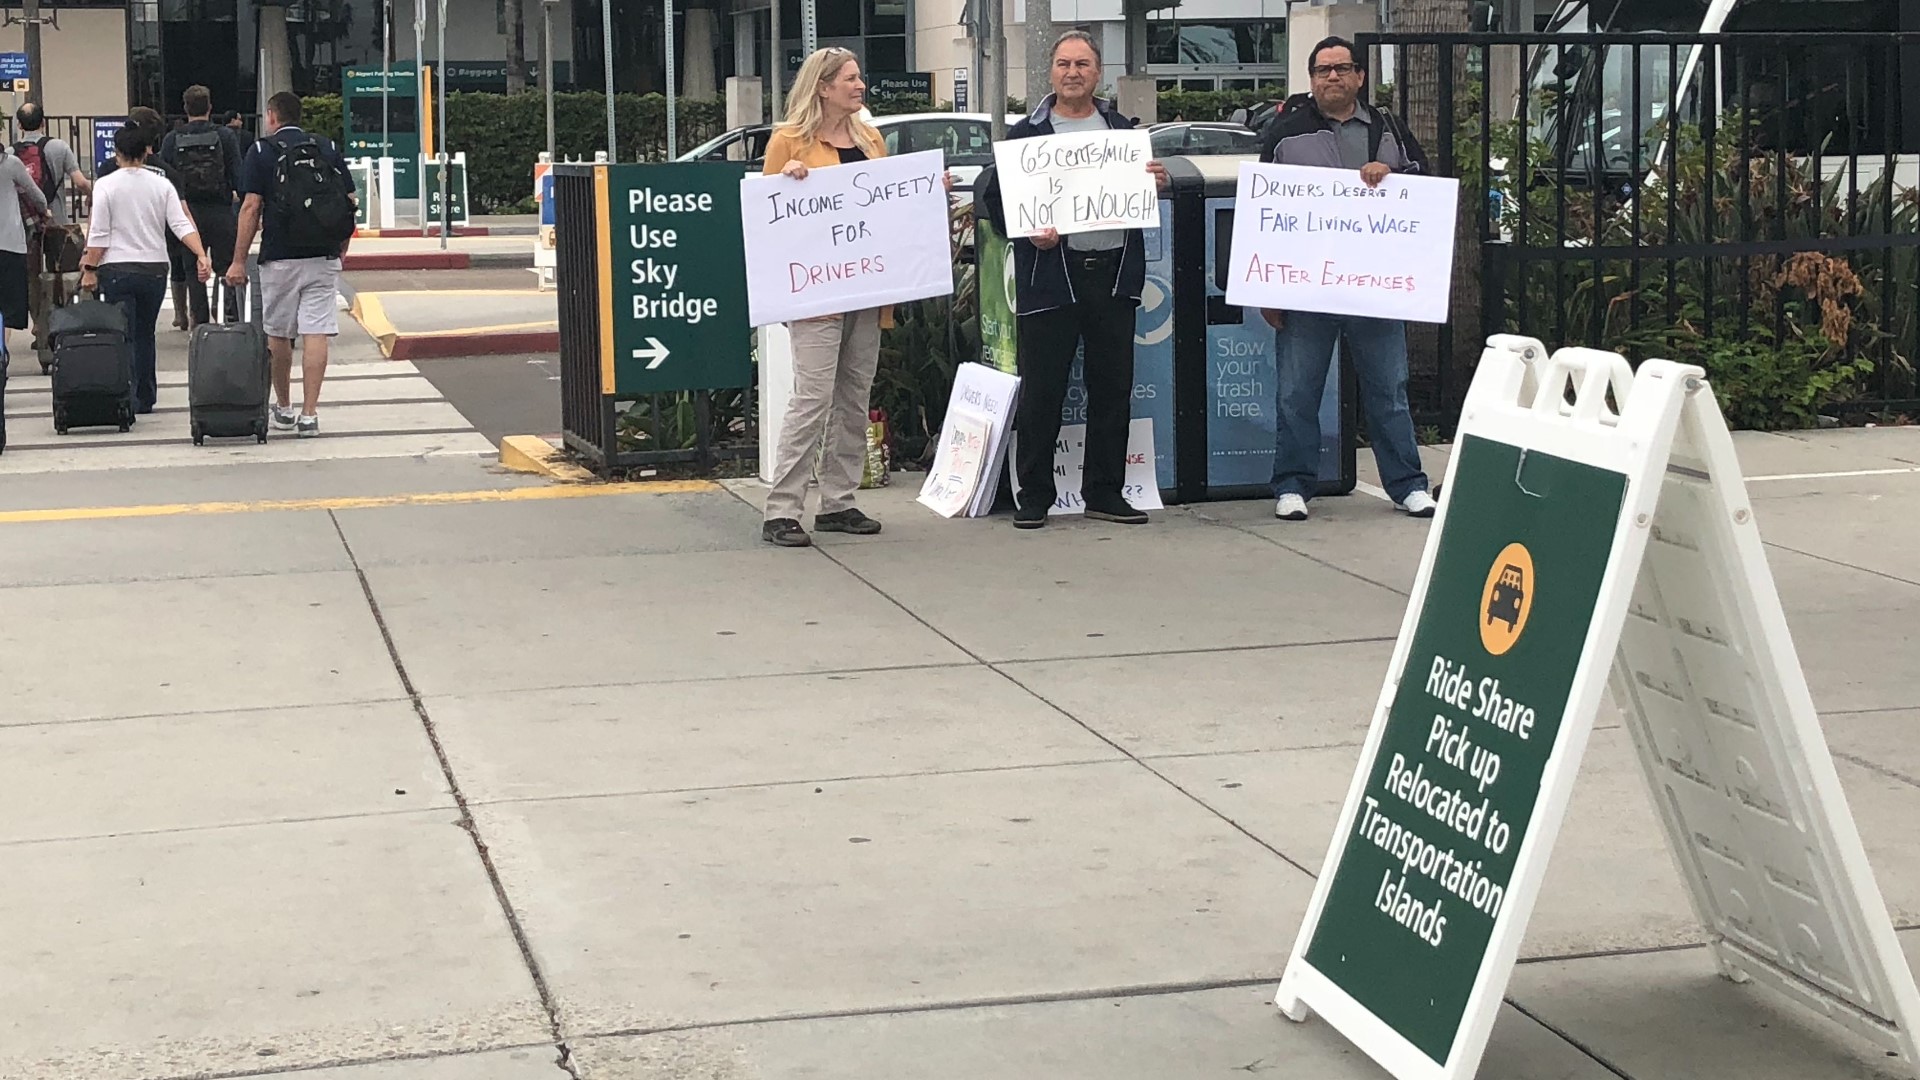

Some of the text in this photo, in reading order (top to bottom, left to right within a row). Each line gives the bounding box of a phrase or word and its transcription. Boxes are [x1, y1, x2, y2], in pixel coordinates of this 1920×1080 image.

[881, 79, 928, 88] Please Use
[1020, 140, 1051, 173] 65
[628, 187, 713, 213] Please
[768, 172, 936, 224] INCOME SAFETY
[1251, 173, 1408, 200] DRIVERS DESERVE A
[1019, 196, 1062, 230] NOT
[1367, 213, 1421, 234] WAGE
[630, 224, 678, 249] Use
[832, 221, 872, 246] FOR
[631, 257, 678, 290] Sky
[789, 255, 885, 293] DRIVERS
[1245, 253, 1312, 285] AFTER
[632, 291, 718, 324] Bridge
[1217, 337, 1266, 357] Slow
[1216, 360, 1261, 380] your
[1217, 378, 1263, 398] trash
[1217, 399, 1264, 418] here.
[1425, 655, 1535, 740] Ride Share
[1425, 714, 1500, 793] Pick up
[1384, 753, 1510, 855] Relocated to
[1359, 795, 1504, 919] Transportation
[1374, 868, 1447, 947] Islands
